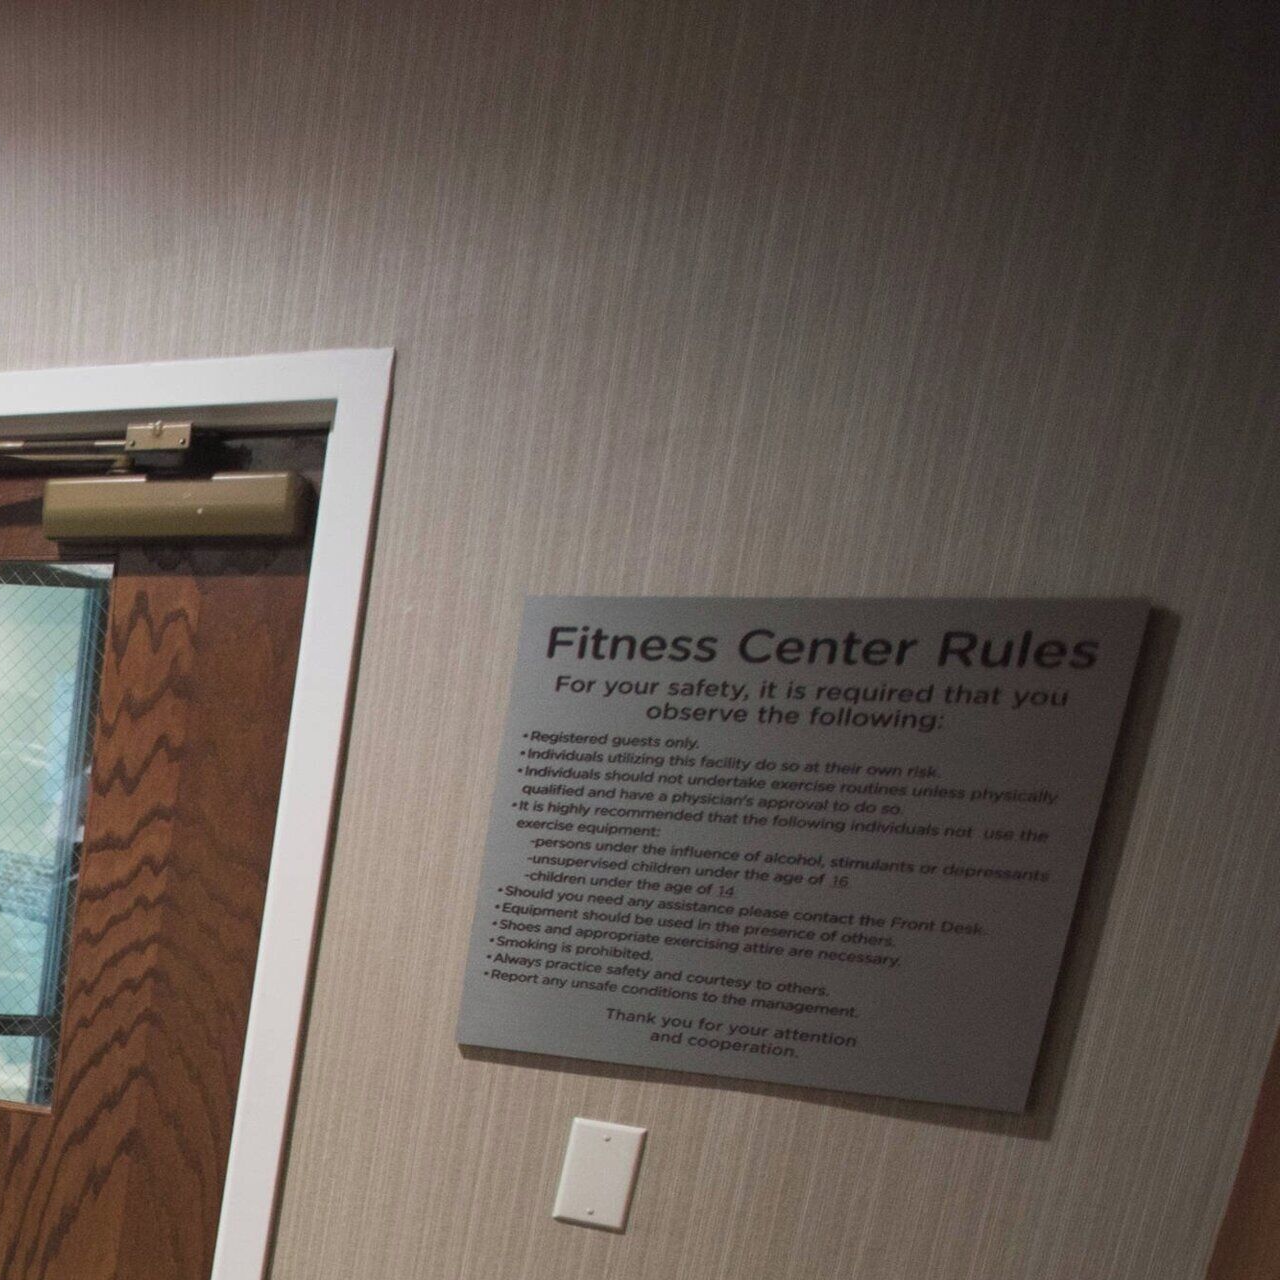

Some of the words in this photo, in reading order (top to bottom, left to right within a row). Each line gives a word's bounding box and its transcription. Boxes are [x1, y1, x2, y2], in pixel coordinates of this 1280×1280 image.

[546, 625, 718, 663] Fitness
[738, 628, 919, 667] Center
[937, 629, 1099, 670] Rules
[555, 675, 596, 693] For
[603, 681, 660, 697] your
[668, 678, 749, 702] safety,
[759, 681, 777, 699] it
[786, 681, 806, 700] is
[815, 684, 935, 705] required
[944, 684, 1002, 705] that
[1012, 691, 1069, 710] you
[646, 702, 748, 723] observe
[758, 705, 800, 725] the
[809, 706, 944, 733] following:
[530, 730, 609, 745] Registered
[612, 737, 661, 748] guests
[664, 737, 699, 752] only.
[527, 748, 603, 763] Individuals
[607, 753, 665, 767] utilizing
[669, 755, 695, 767] this
[701, 756, 751, 772] facility
[755, 759, 776, 771] do
[781, 762, 800, 772] so
[804, 762, 820, 773] at
[825, 762, 862, 774] their
[866, 766, 902, 776] own
[522, 784, 585, 797] qualified
[587, 788, 616, 799] and
[619, 789, 654, 801] have
[658, 793, 668, 802] a
[671, 792, 753, 806] physician's
[758, 799, 829, 811] approval
[833, 801, 850, 812] to
[854, 801, 877, 813] do
[525, 766, 601, 780] Individuals
[605, 770, 655, 783] should
[658, 774, 683, 784] not
[687, 775, 766, 789] undertake
[771, 780, 836, 792] exercise
[840, 783, 906, 796] routines
[912, 786, 965, 799] unless
[970, 788, 1058, 805] physically
[516, 819, 574, 831] exercise
[577, 822, 661, 838] equipment:
[519, 800, 529, 811] It
[532, 803, 544, 812] is
[547, 802, 591, 817] highly
[594, 807, 704, 822] recommended
[708, 812, 738, 824] that
[743, 814, 768, 826] the
[772, 815, 846, 833] following
[850, 821, 939, 836] individuals
[944, 827, 973, 838] not
[984, 830, 1014, 840] use
[1020, 829, 1049, 842] the
[595, 842, 638, 853] under
[642, 844, 667, 855] the
[670, 845, 740, 861] influence
[744, 850, 761, 862] of
[764, 852, 825, 869] alcohol,
[830, 857, 914, 873] stimulants
[920, 865, 937, 874] or
[942, 864, 1048, 882] depressants
[631, 861, 691, 875] children
[695, 866, 740, 878] under
[744, 869, 770, 881] the
[773, 873, 804, 885] age
[807, 873, 826, 885] of
[590, 877, 633, 888] under
[637, 879, 661, 891] the
[664, 883, 693, 895] age
[696, 884, 713, 895] of
[502, 902, 578, 919] Equipment
[582, 910, 631, 924] should
[634, 914, 654, 926] be
[657, 918, 694, 929] used
[697, 921, 711, 930] in
[715, 921, 740, 933] the
[743, 926, 816, 940] presence
[819, 930, 838, 941] of
[505, 885, 554, 900] Should
[557, 892, 584, 902] you
[587, 894, 624, 906] need
[627, 898, 654, 910] any
[657, 900, 735, 914] assistance
[738, 906, 789, 919] please
[793, 912, 854, 925] contact
[859, 915, 885, 927] the
[890, 917, 935, 931] Front
[497, 935, 558, 954] Smoking
[561, 944, 572, 953] is
[575, 945, 653, 962] prohibited.
[500, 919, 541, 933] Shoes
[544, 925, 572, 936] and
[575, 928, 660, 944] appropriate
[664, 936, 740, 954] exercising
[743, 943, 784, 956] attire
[788, 947, 814, 958] are
[817, 950, 901, 969] necessary.
[493, 952, 542, 968] Always
[545, 960, 602, 973] practice
[607, 965, 650, 980] safety
[653, 970, 683, 981] and
[686, 974, 752, 990] courtesy
[756, 979, 772, 991] to
[491, 968, 539, 984] Report
[542, 977, 568, 989] any
[571, 980, 617, 992] unsafe
[621, 985, 698, 1001] conditions
[702, 992, 718, 1003] to
[722, 993, 747, 1006] the
[750, 998, 858, 1018] management.
[607, 1007, 656, 1024] Thank
[661, 1017, 693, 1029] you
[698, 1017, 723, 1031] for
[729, 1025, 768, 1036] your
[773, 1028, 857, 1047] attention
[650, 1032, 683, 1044] and
[687, 1036, 799, 1059] cooperation.
